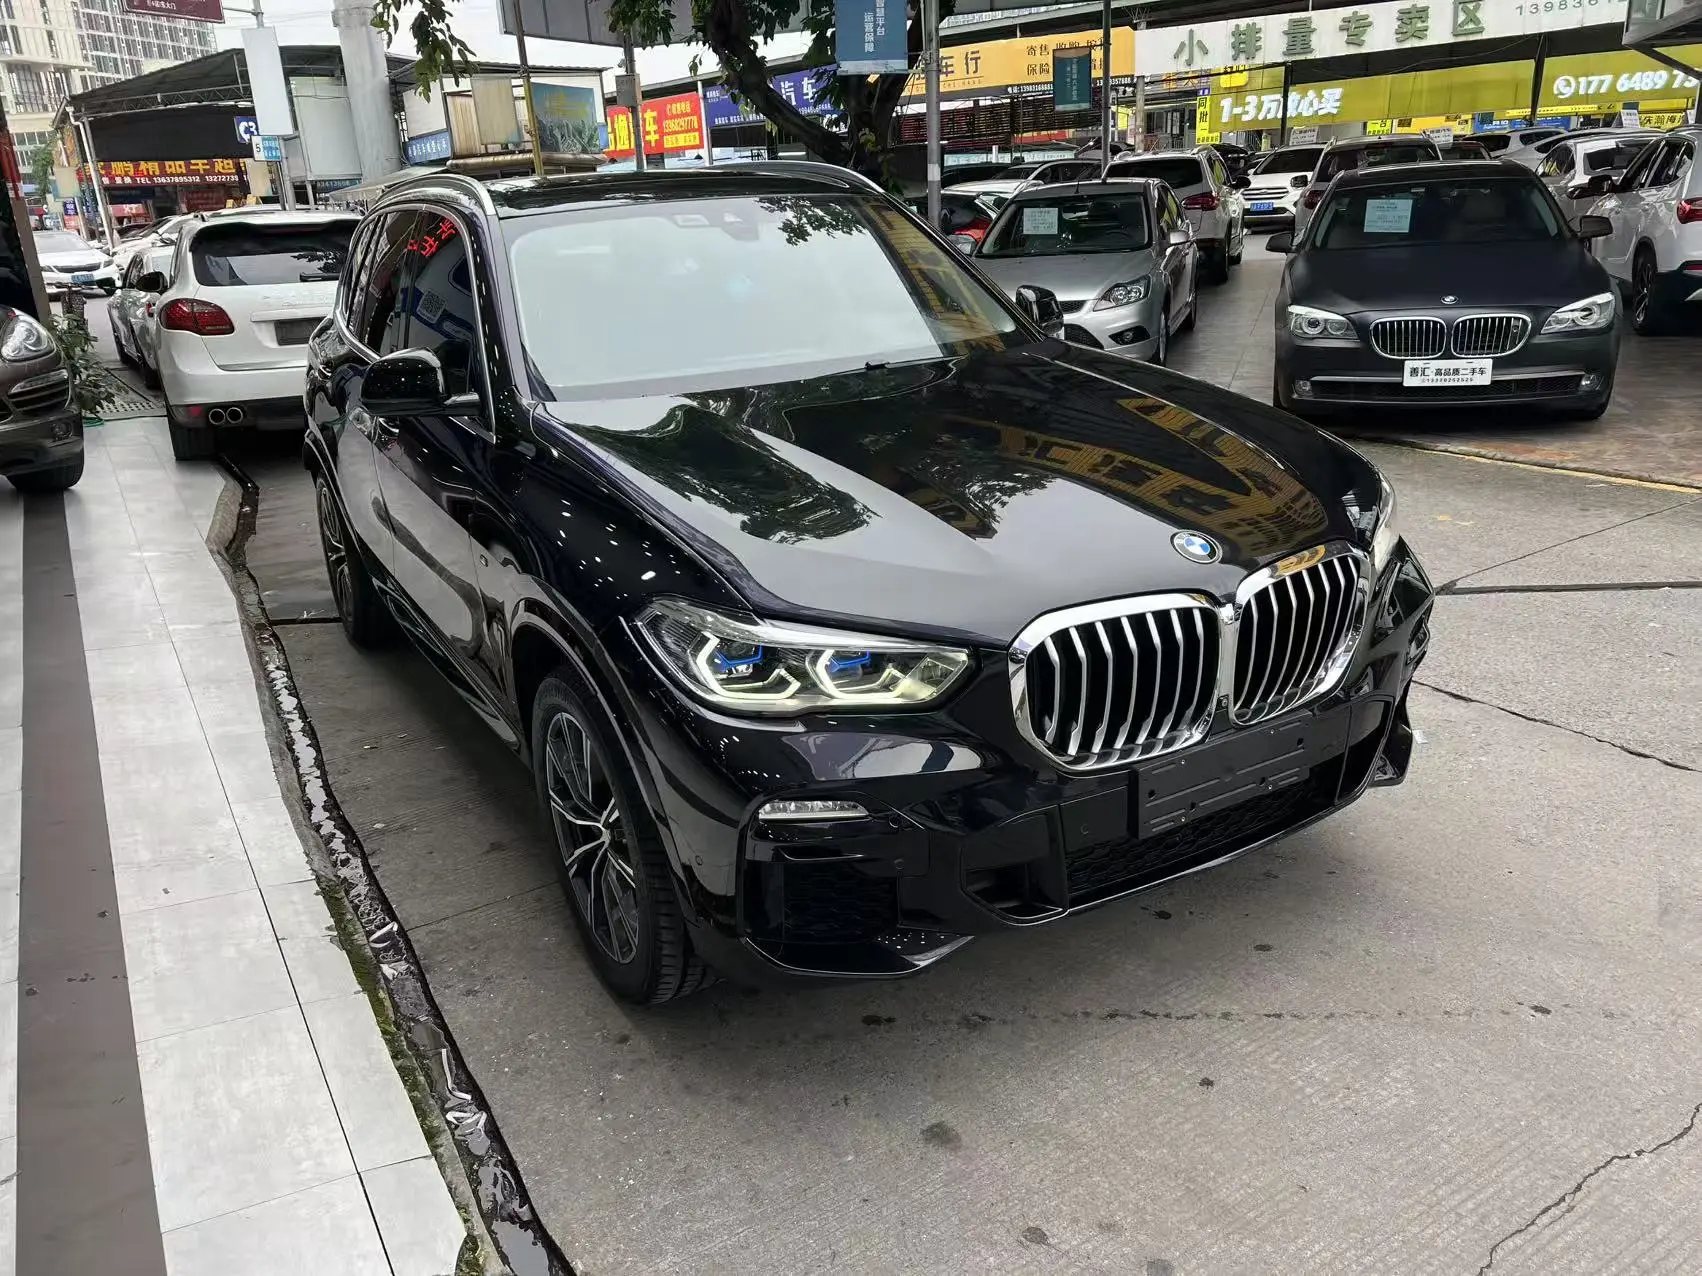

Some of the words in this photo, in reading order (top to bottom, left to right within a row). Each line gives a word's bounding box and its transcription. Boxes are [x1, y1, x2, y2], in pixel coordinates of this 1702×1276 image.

[864, 12, 875, 53] 运营保障
[1173, 0, 1486, 67] 小排量专卖区
[1026, 44, 1050, 57] 寄售
[1026, 63, 1050, 77] 保险
[1577, 74, 1614, 95] 177
[1616, 70, 1669, 93] 6489
[255, 144, 262, 153] 5
